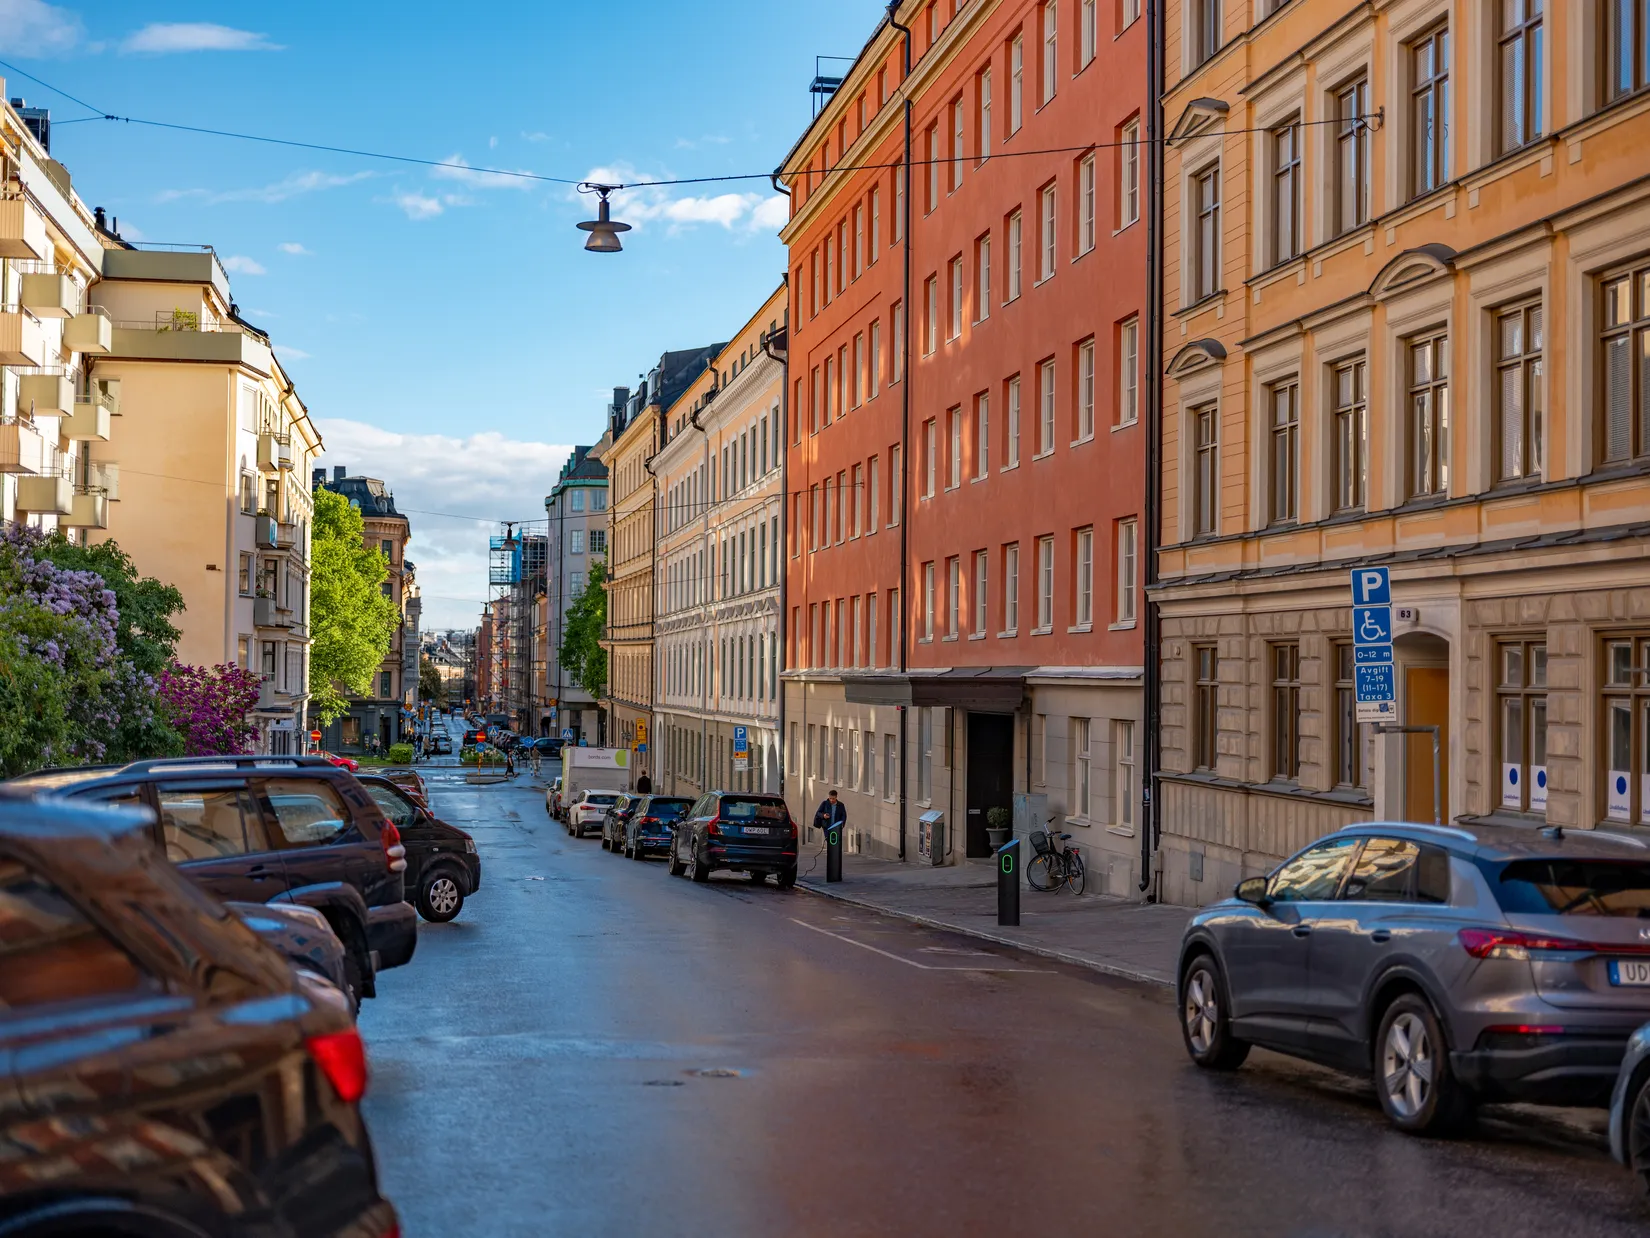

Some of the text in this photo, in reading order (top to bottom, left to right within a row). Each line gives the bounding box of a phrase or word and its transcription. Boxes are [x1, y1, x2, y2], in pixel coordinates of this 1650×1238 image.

[1361, 571, 1383, 602] P
[1400, 610, 1411, 618] 63
[1360, 666, 1389, 675] Avgift
[1362, 683, 1388, 692] (11-17)
[737, 727, 744, 738] P
[1626, 964, 1650, 981] UD
